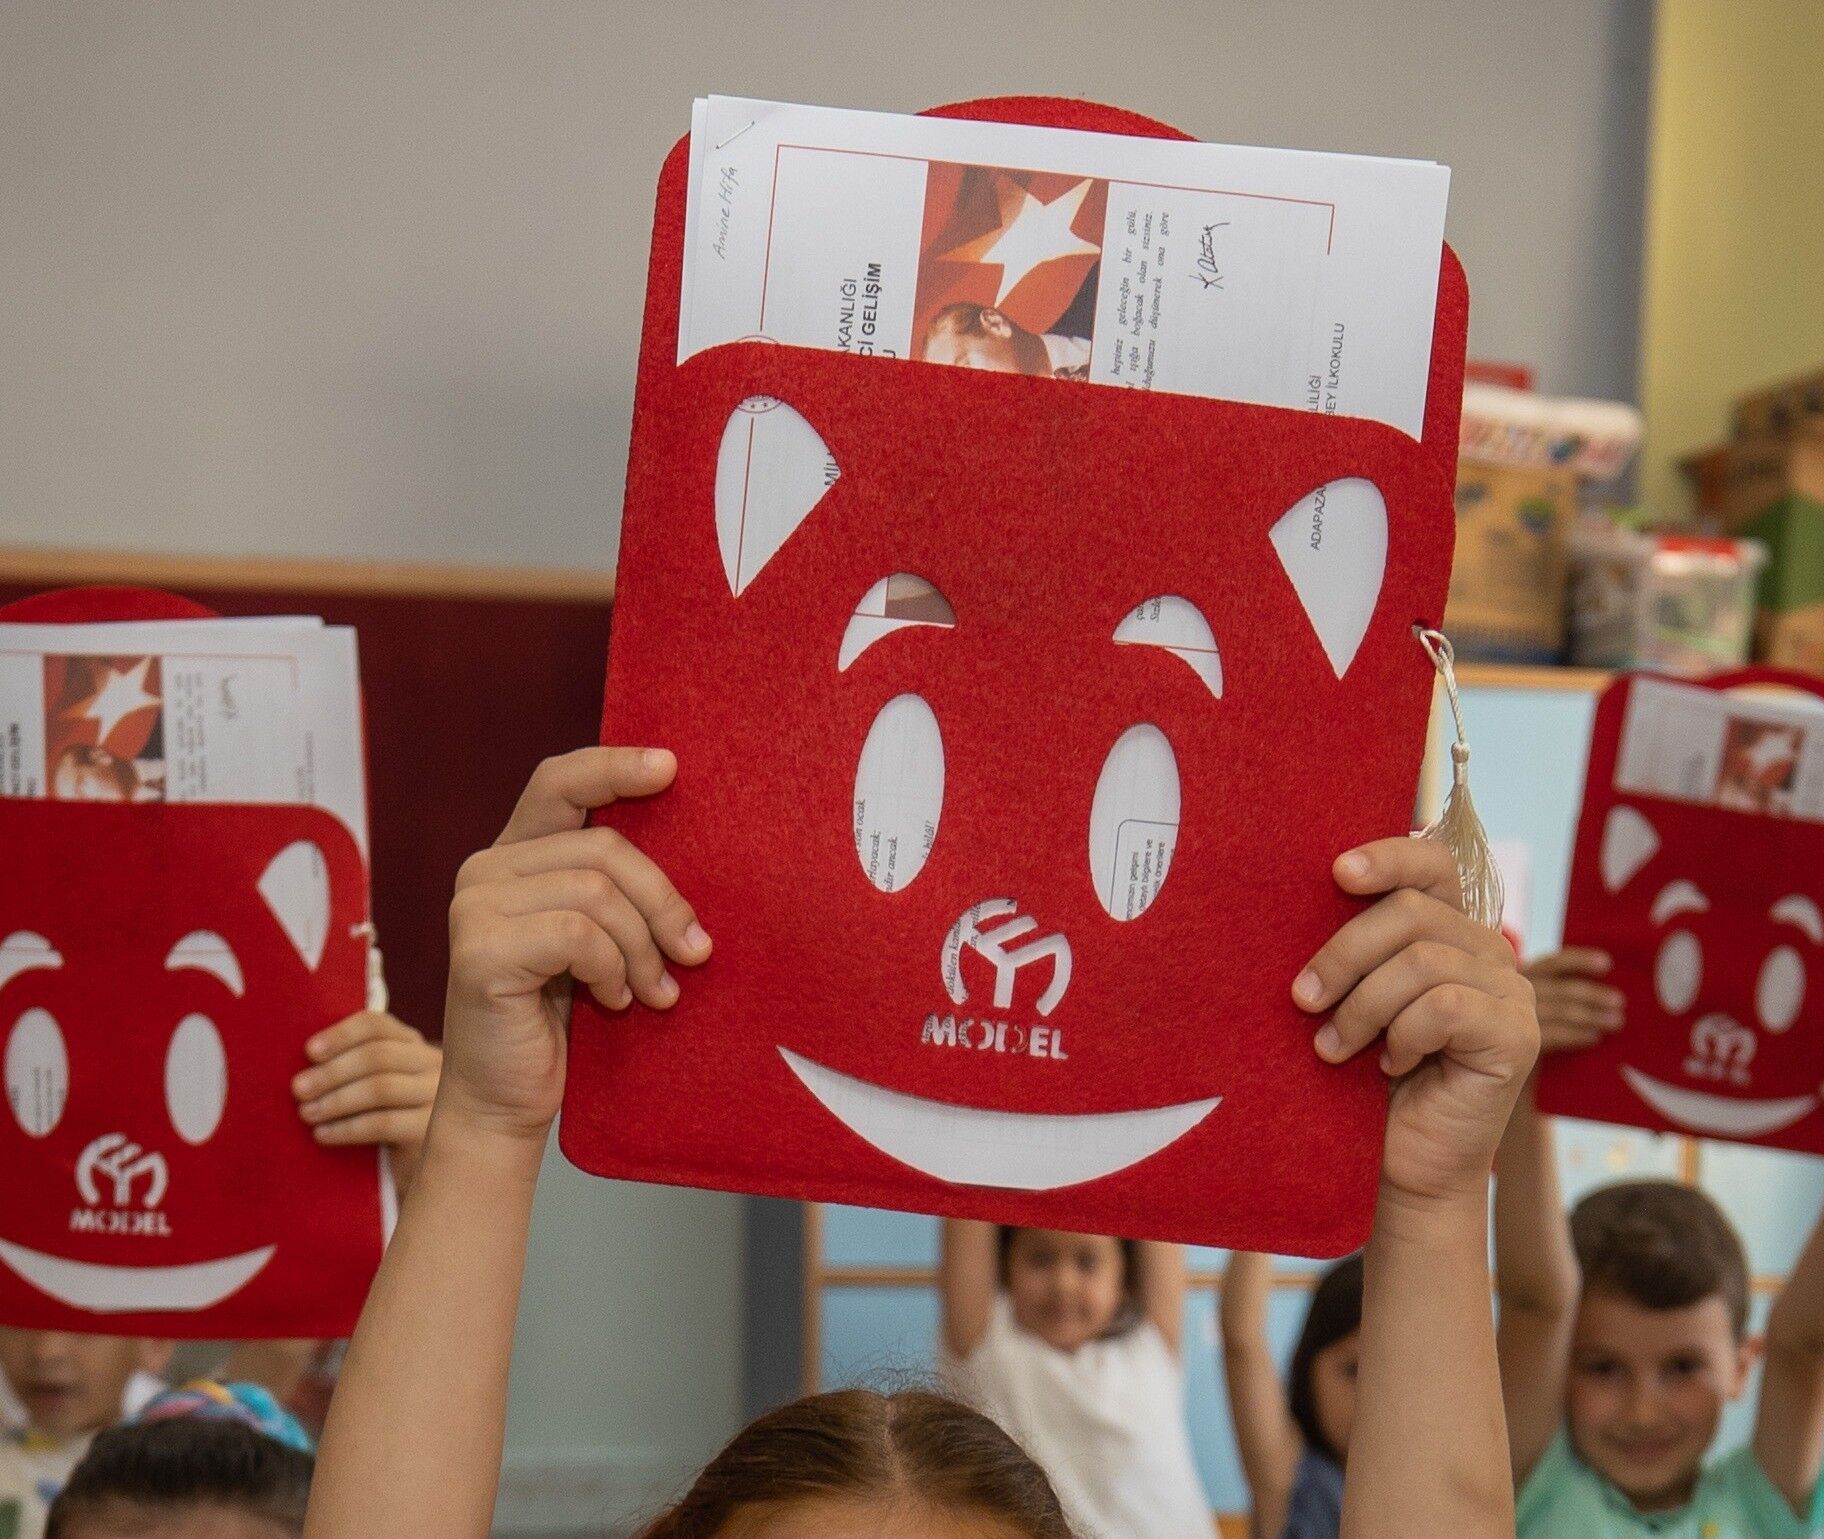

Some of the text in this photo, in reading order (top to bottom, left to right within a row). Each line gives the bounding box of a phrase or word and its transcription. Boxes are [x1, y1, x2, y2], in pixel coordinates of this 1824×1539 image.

[1122, 247, 1133, 264] bir
[1137, 260, 1148, 284] olan
[837, 278, 857, 354] KANLIĞI
[857, 262, 882, 358] Cİ GELİŞİM
[1118, 276, 1131, 326] geleceğin
[1131, 294, 1144, 337] boğacak
[1141, 212, 1170, 390] duğunuzu düşünerek ona göre
[1110, 338, 1123, 376] hepiniz
[1325, 323, 1345, 389] İLKOKULU
[921, 1012, 1069, 1060] MODEL
